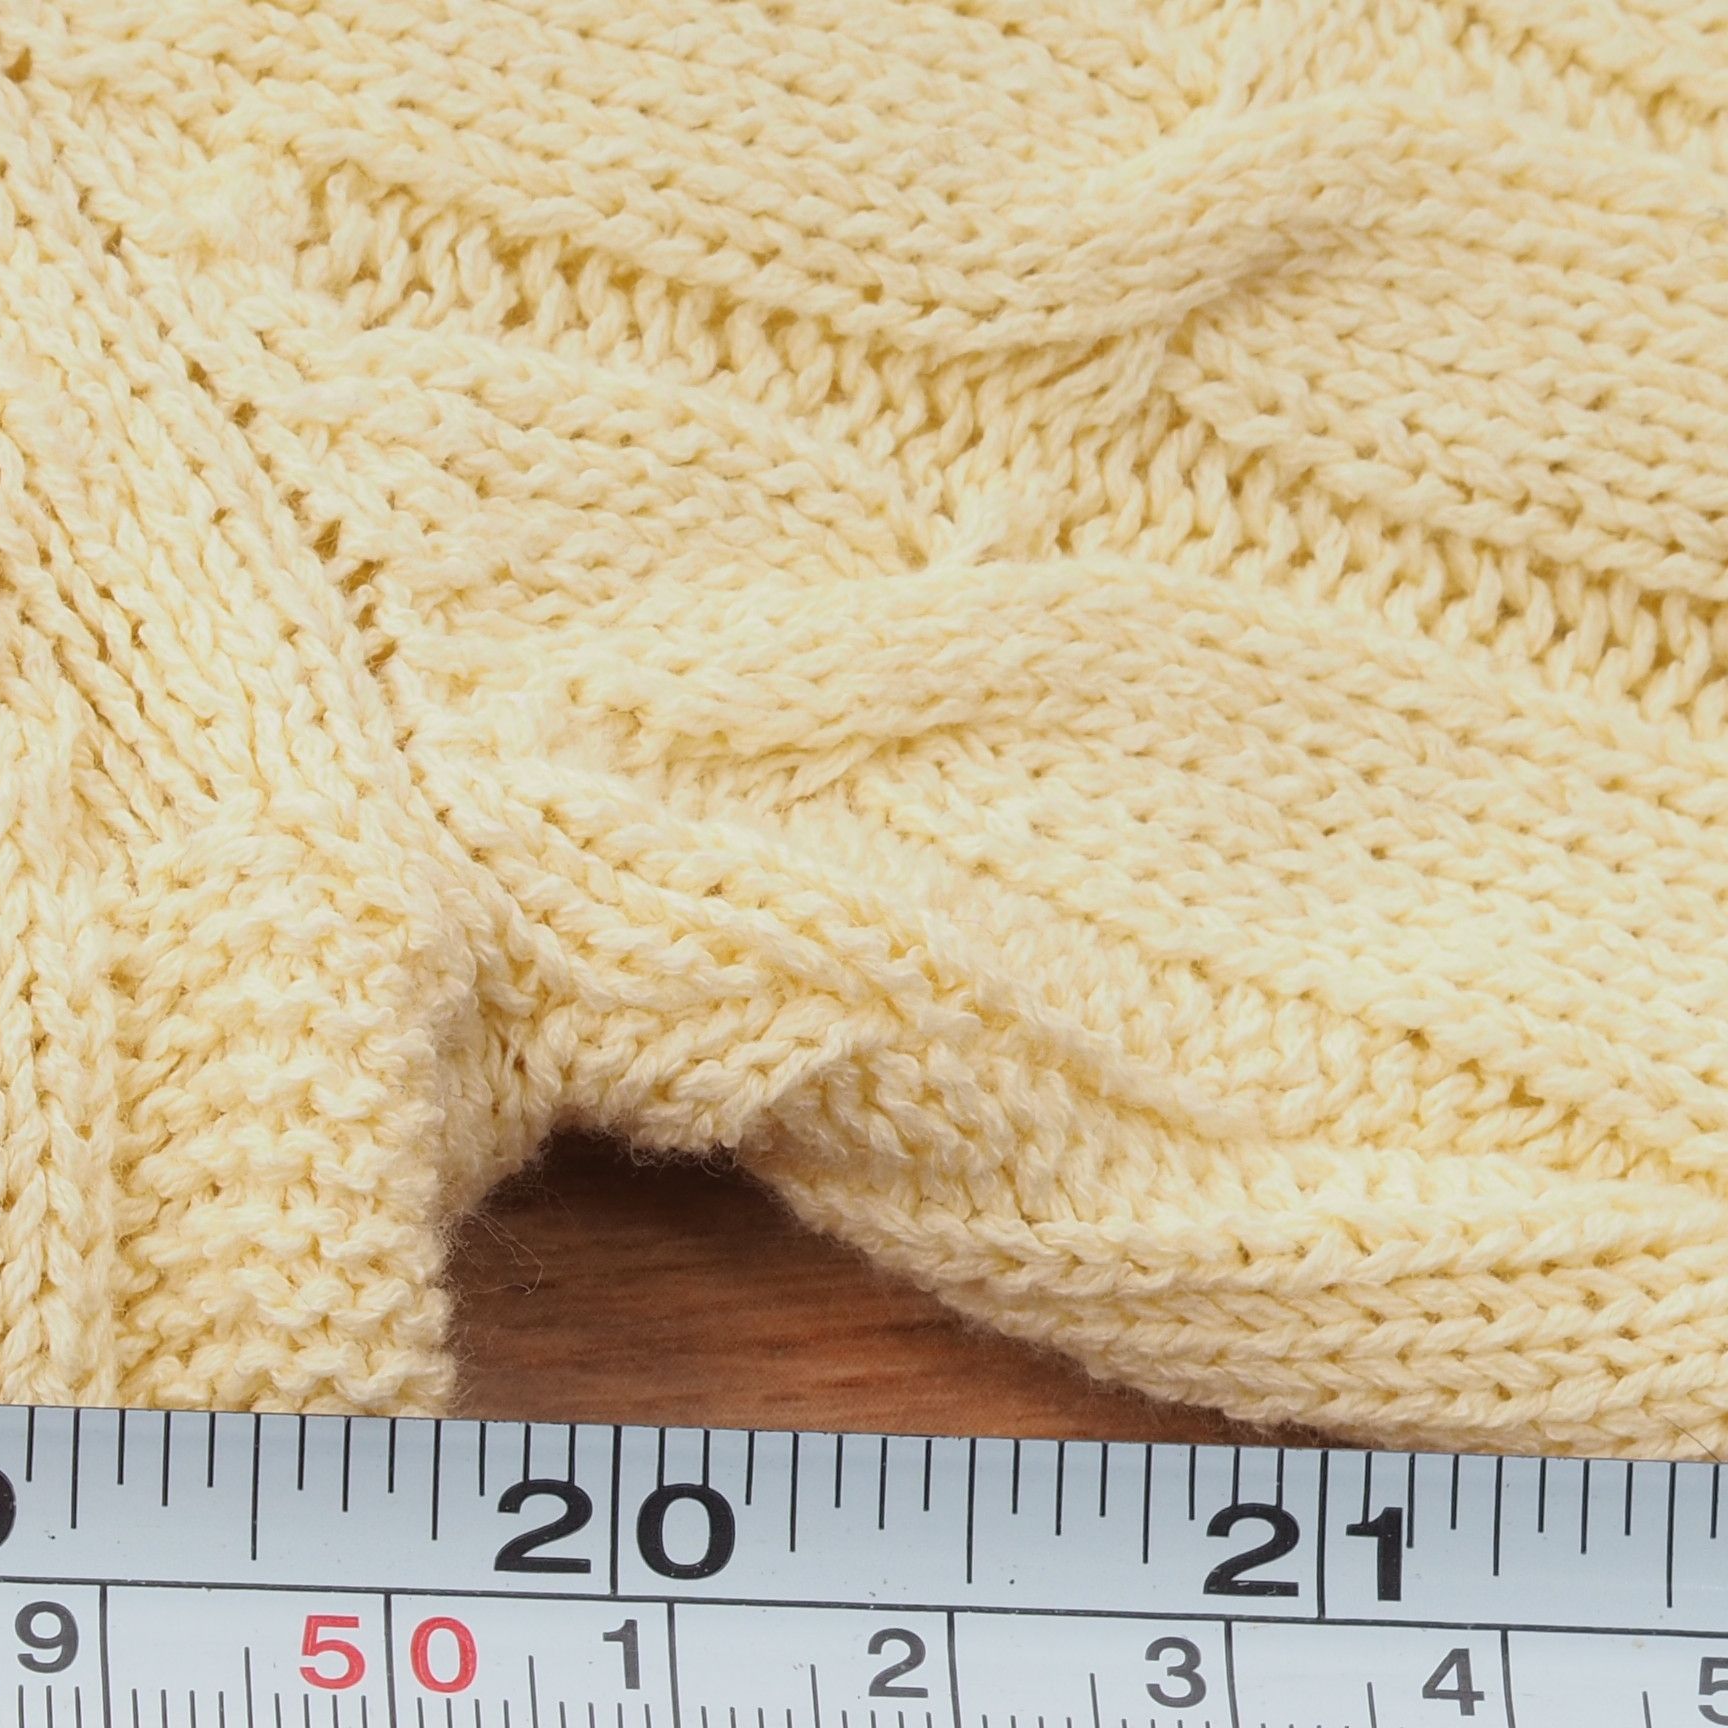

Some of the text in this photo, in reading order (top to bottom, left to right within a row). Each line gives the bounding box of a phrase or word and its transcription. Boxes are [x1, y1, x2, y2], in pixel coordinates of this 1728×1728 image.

[493, 1478, 735, 1580] 20
[1203, 1501, 1403, 1602] 21
[14, 1601, 79, 1673] 9
[299, 1614, 478, 1693] 50
[602, 1619, 642, 1690] 1
[867, 1628, 928, 1699] 2
[1145, 1637, 1206, 1708] 3
[1421, 1648, 1484, 1716] 4
